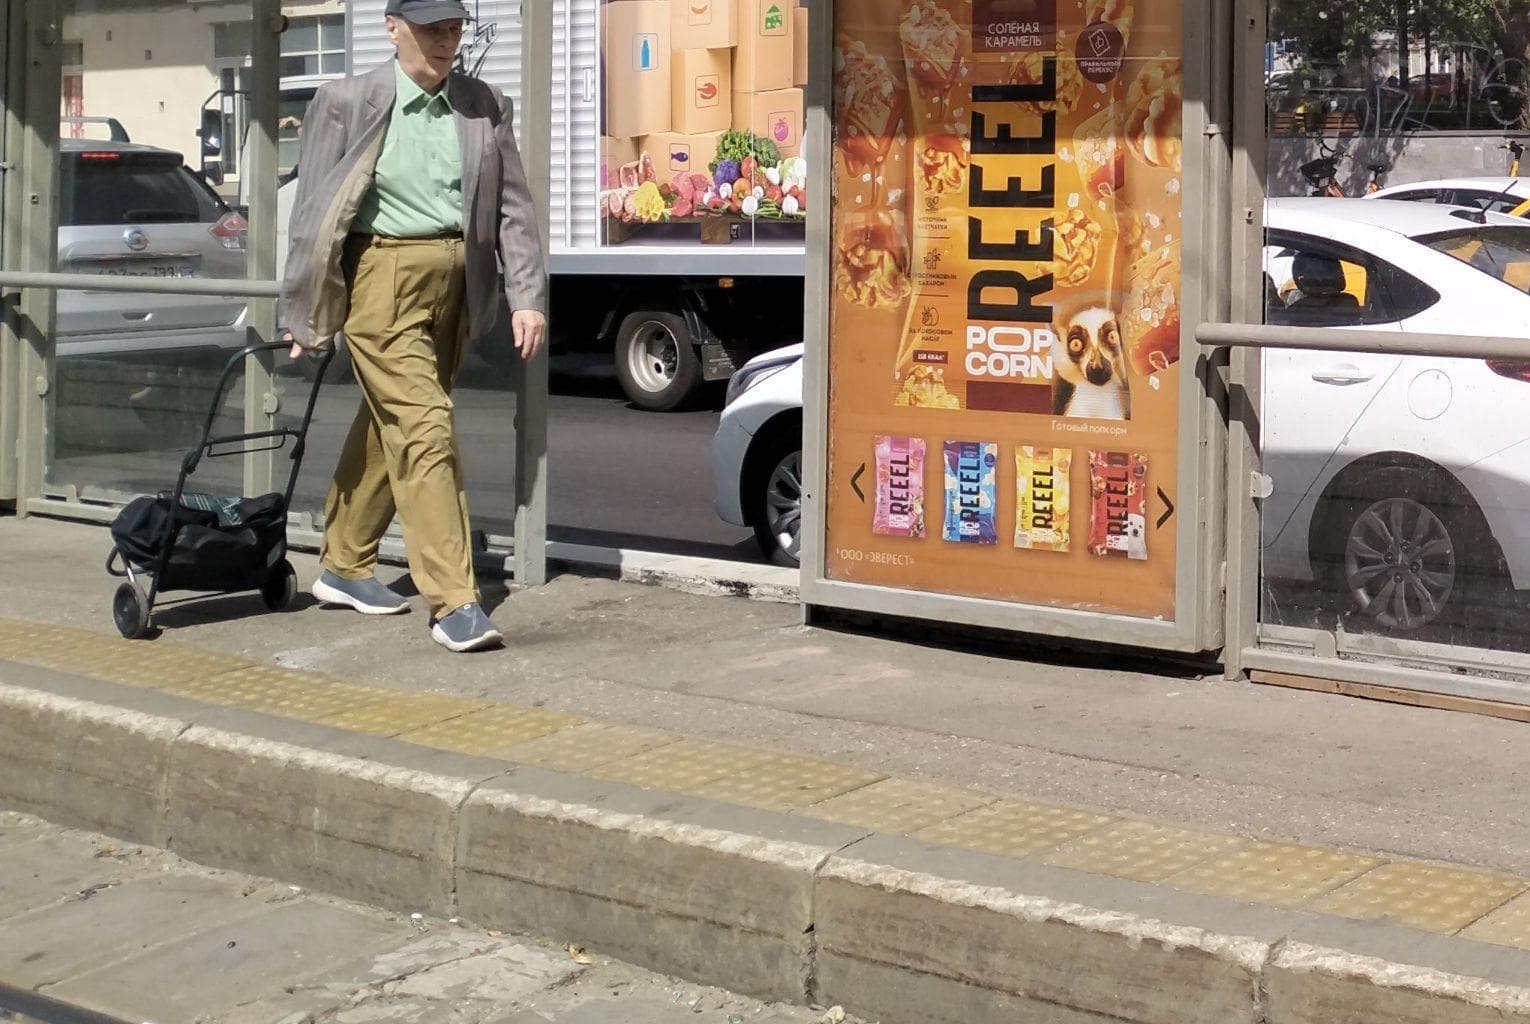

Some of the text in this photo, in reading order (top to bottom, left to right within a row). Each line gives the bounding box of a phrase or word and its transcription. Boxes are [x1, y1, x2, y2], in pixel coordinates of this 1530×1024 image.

[985, 35, 1042, 48] КАРАМЕЛЬ
[967, 55, 1057, 323] REEEL
[966, 325, 1053, 352] POP
[965, 351, 1053, 379] CORN
[1051, 420, 1127, 436] Готовый попкорн
[889, 454, 910, 515] REEEL
[959, 462, 981, 522] REEEL
[1031, 465, 1054, 529] REEEL
[1106, 471, 1129, 536] REEEL
[840, 548, 863, 561] ООО
